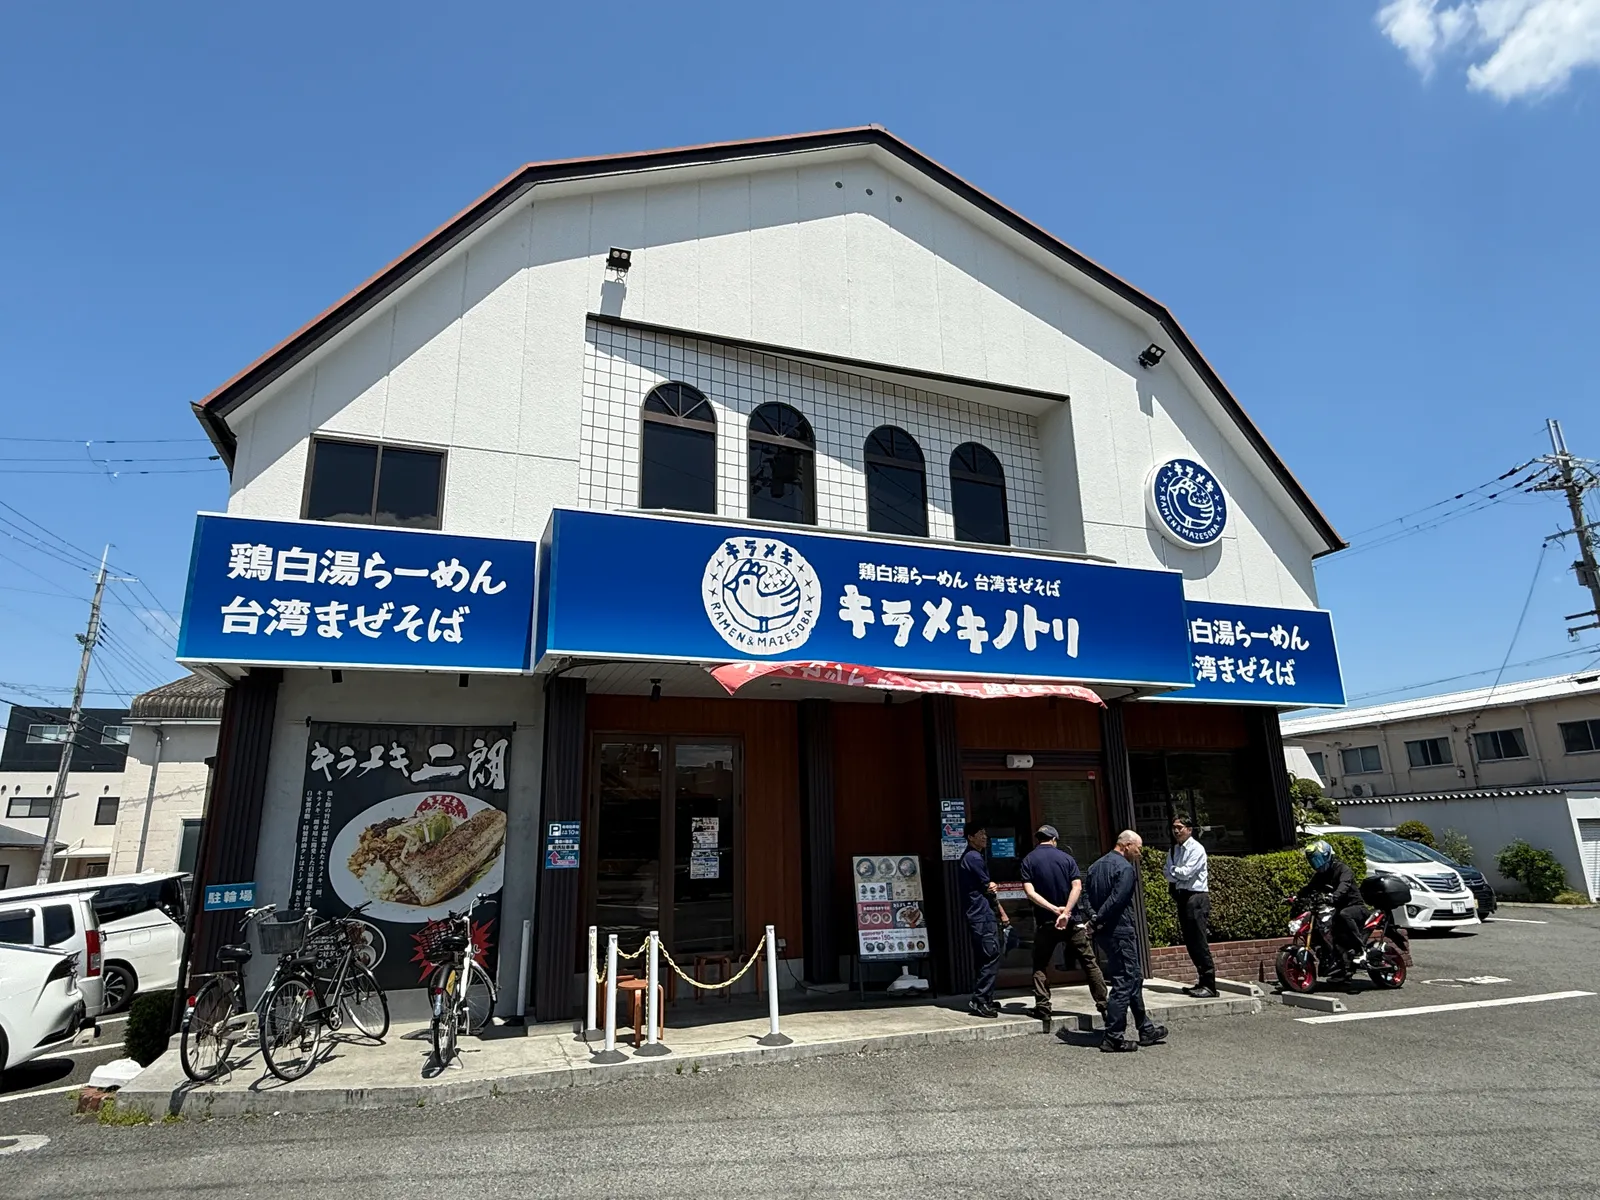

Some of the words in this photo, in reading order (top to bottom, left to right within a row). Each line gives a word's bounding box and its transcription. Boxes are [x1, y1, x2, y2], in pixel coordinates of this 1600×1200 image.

[1174, 462, 1214, 492] キラメキ
[227, 542, 508, 595] 鶏白湯らーめん
[725, 539, 794, 566] キラメキ
[858, 562, 969, 589] 鶏白湯らーめん
[973, 573, 1061, 597] 台湾まぜそば
[219, 596, 472, 644] 台湾まぜそば
[838, 584, 1080, 658] キラメキノトリ
[1187, 617, 1310, 651] 白湯らーめん
[1192, 655, 1296, 686] 湾まぜそば
[207, 889, 253, 904] 駐輪場
